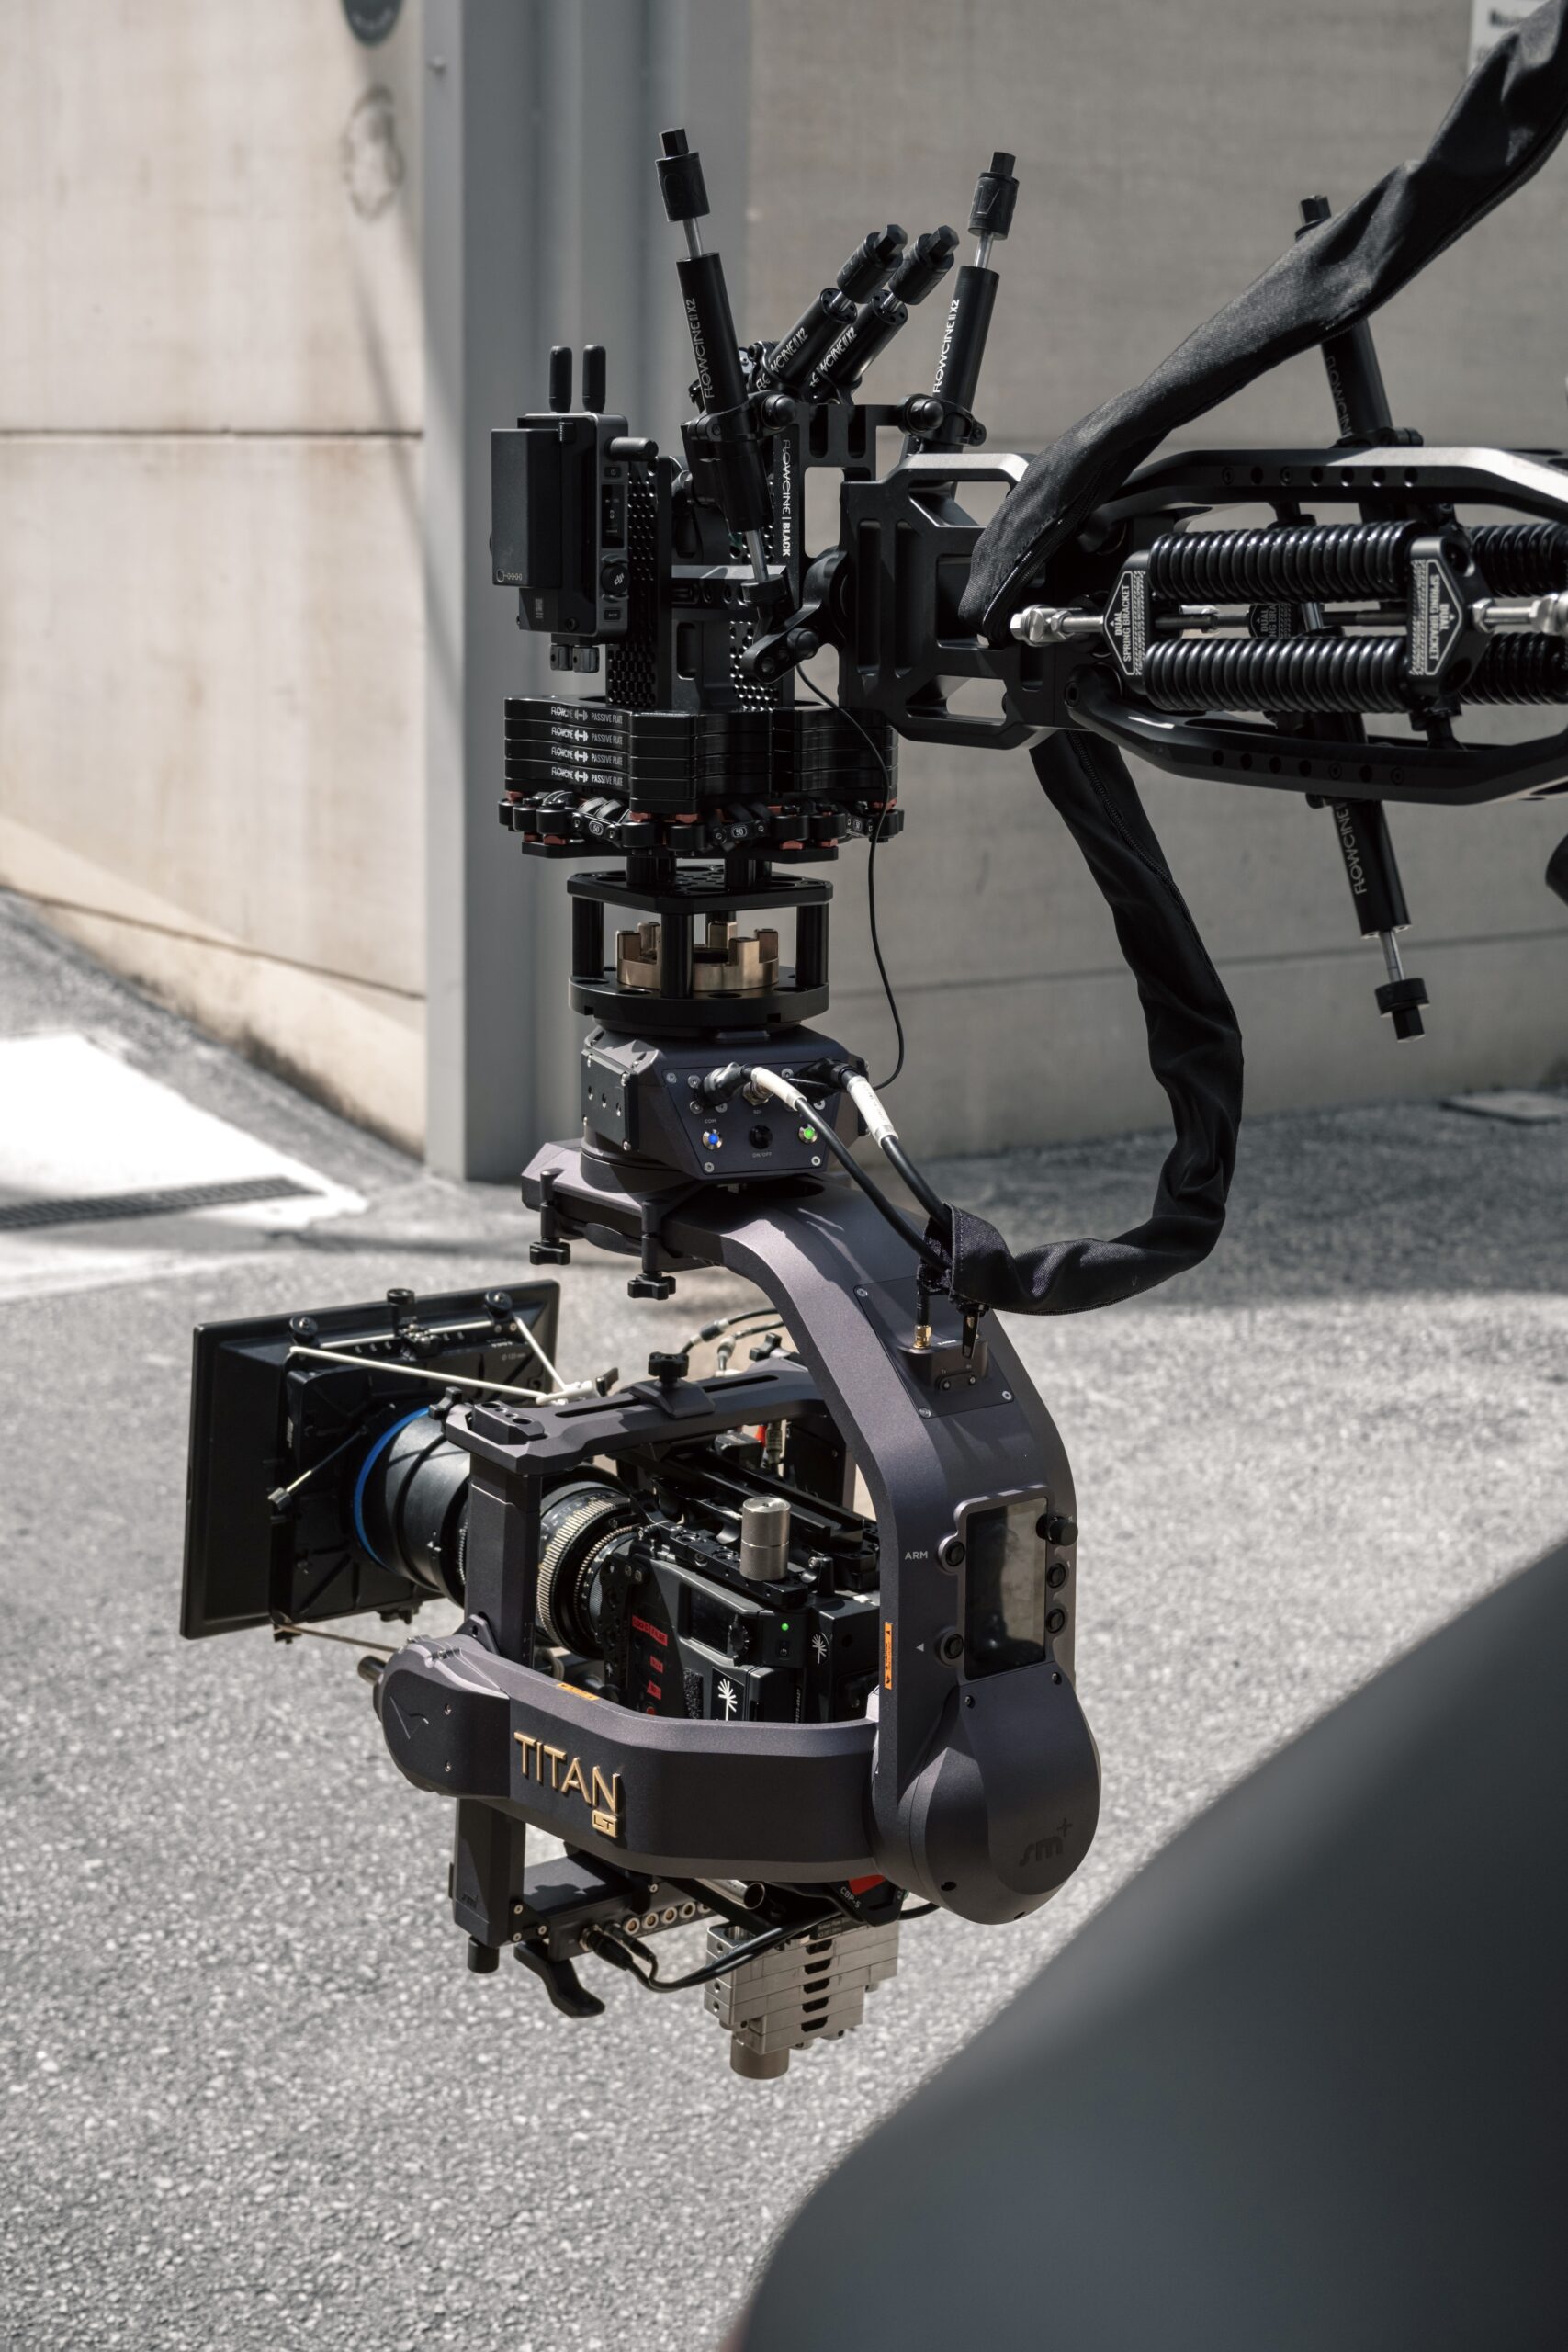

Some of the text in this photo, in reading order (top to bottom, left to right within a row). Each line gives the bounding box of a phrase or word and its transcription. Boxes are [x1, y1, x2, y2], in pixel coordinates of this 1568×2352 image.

[690, 321, 715, 399] FLOWCINE
[932, 321, 956, 393] FLOWCINE
[781, 439, 791, 557] FLOWCINE BLACK
[1113, 611, 1122, 636] DUAL
[1121, 584, 1132, 662] SPRING BRACKET
[1260, 609, 1269, 632] DUAL
[1428, 573, 1440, 661] SPRING BRACKET
[1438, 603, 1450, 630] DUAL
[591, 712, 613, 723] PASSIVE
[591, 733, 613, 744] PASSIVE
[591, 753, 613, 764] PASSIVE
[591, 774, 613, 785] PASSIVE
[1337, 807, 1368, 895] FLOWCINE
[905, 1550, 929, 1560] ARM
[514, 1731, 621, 1816] TITAN
[840, 1886, 862, 1909] CBP-5
